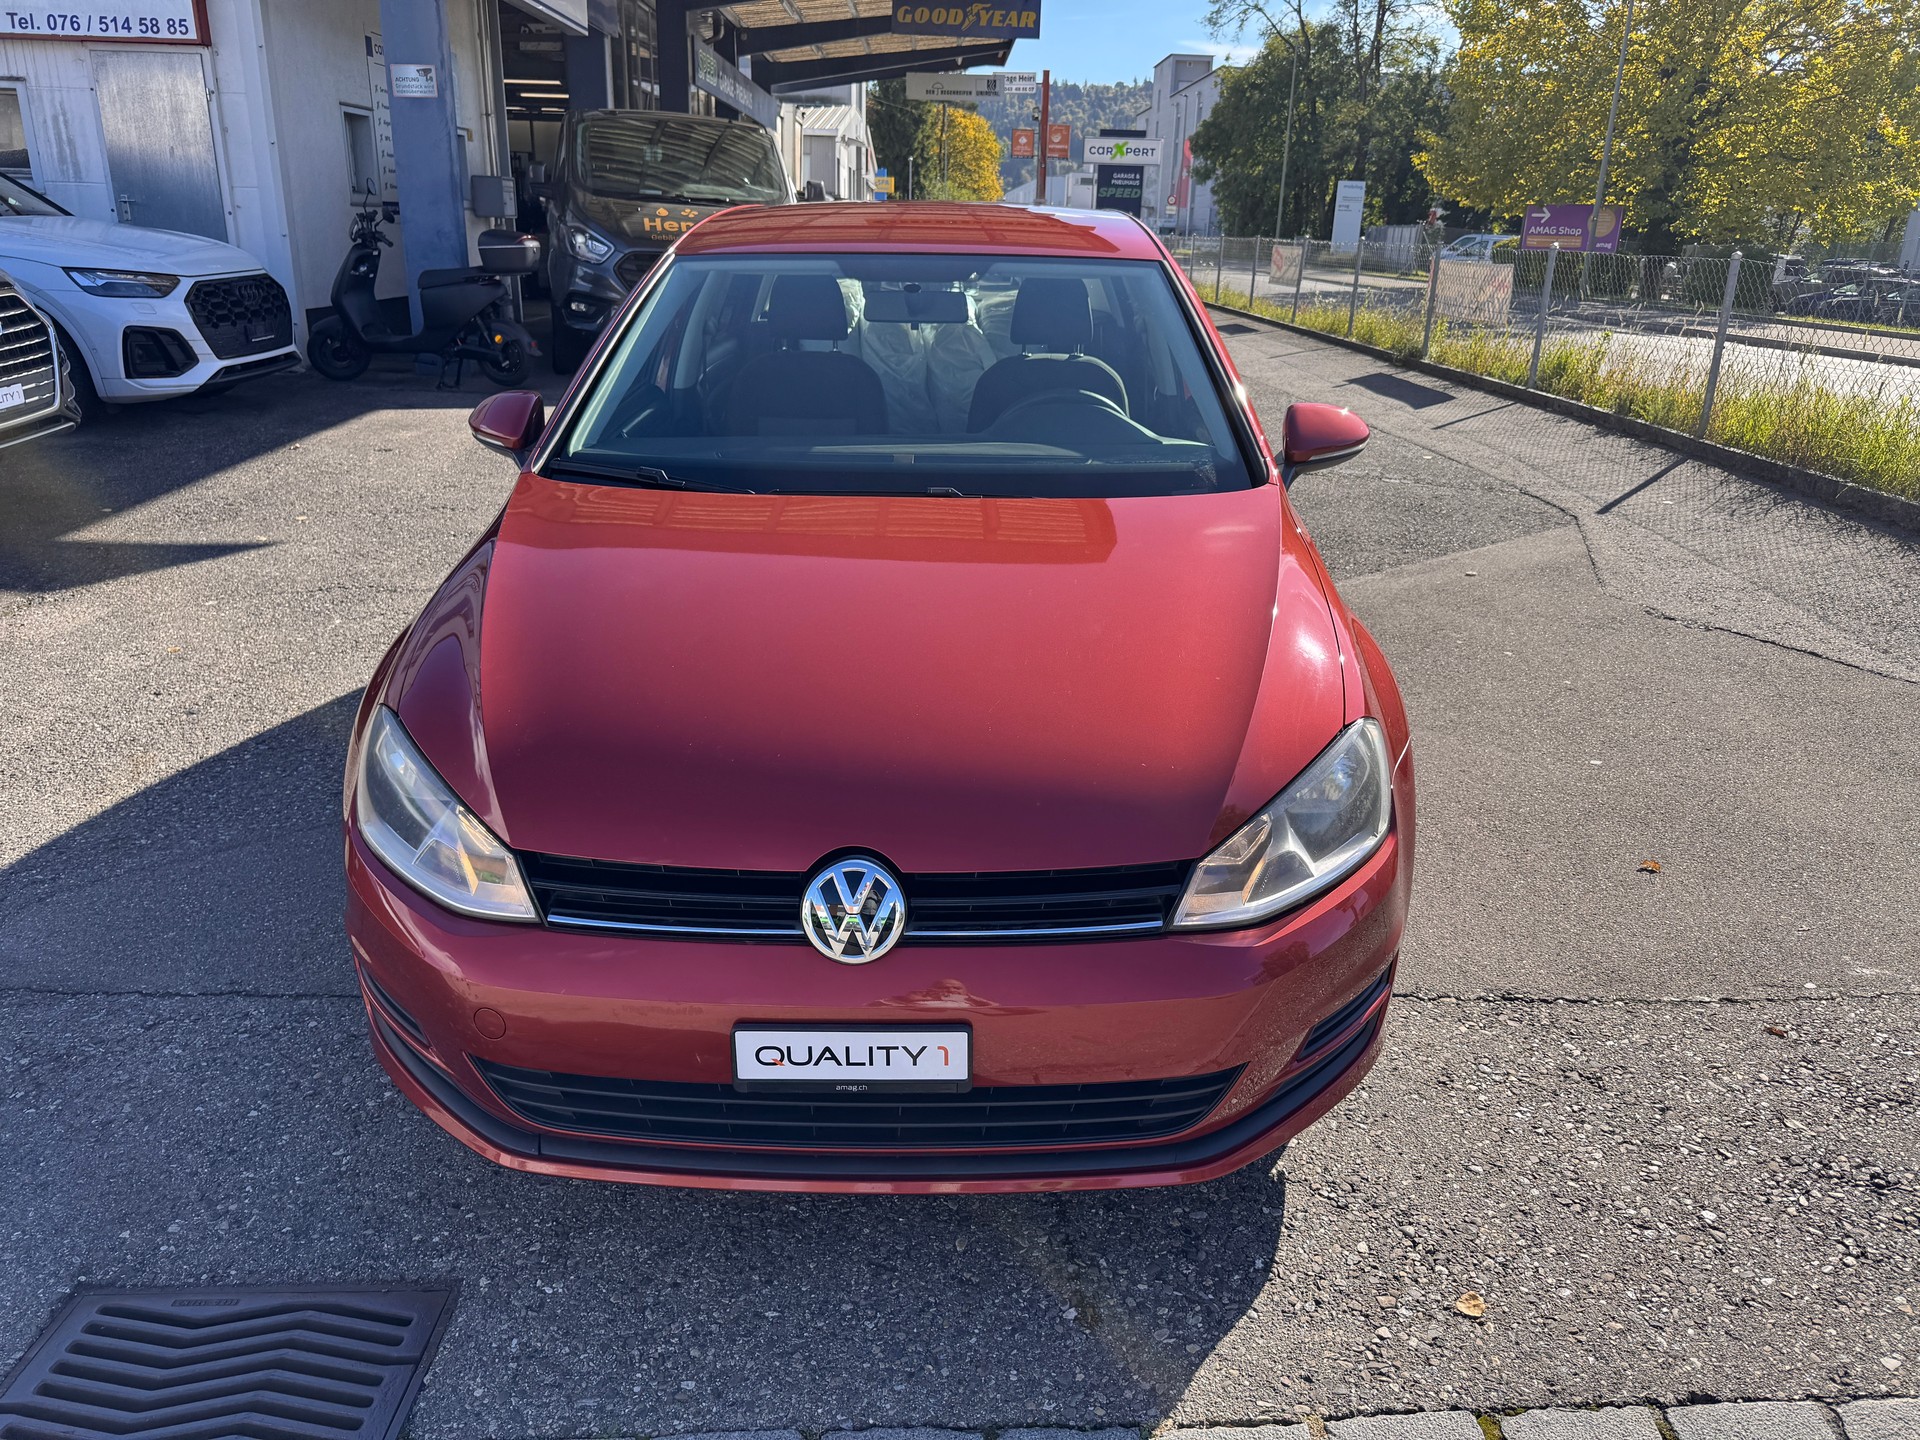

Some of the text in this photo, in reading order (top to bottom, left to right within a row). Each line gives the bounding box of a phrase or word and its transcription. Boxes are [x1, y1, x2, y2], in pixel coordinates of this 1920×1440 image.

[6, 12, 41, 31] Tel.
[47, 14, 81, 32] 076
[99, 16, 132, 34] 514
[139, 17, 161, 35] 58
[167, 18, 190, 36] 85
[1098, 187, 1142, 199] SPEED
[1528, 226, 1582, 236] AMAG Shop
[754, 1045, 949, 1067] QUALITY 1
[835, 1083, 868, 1092] amag.ch
